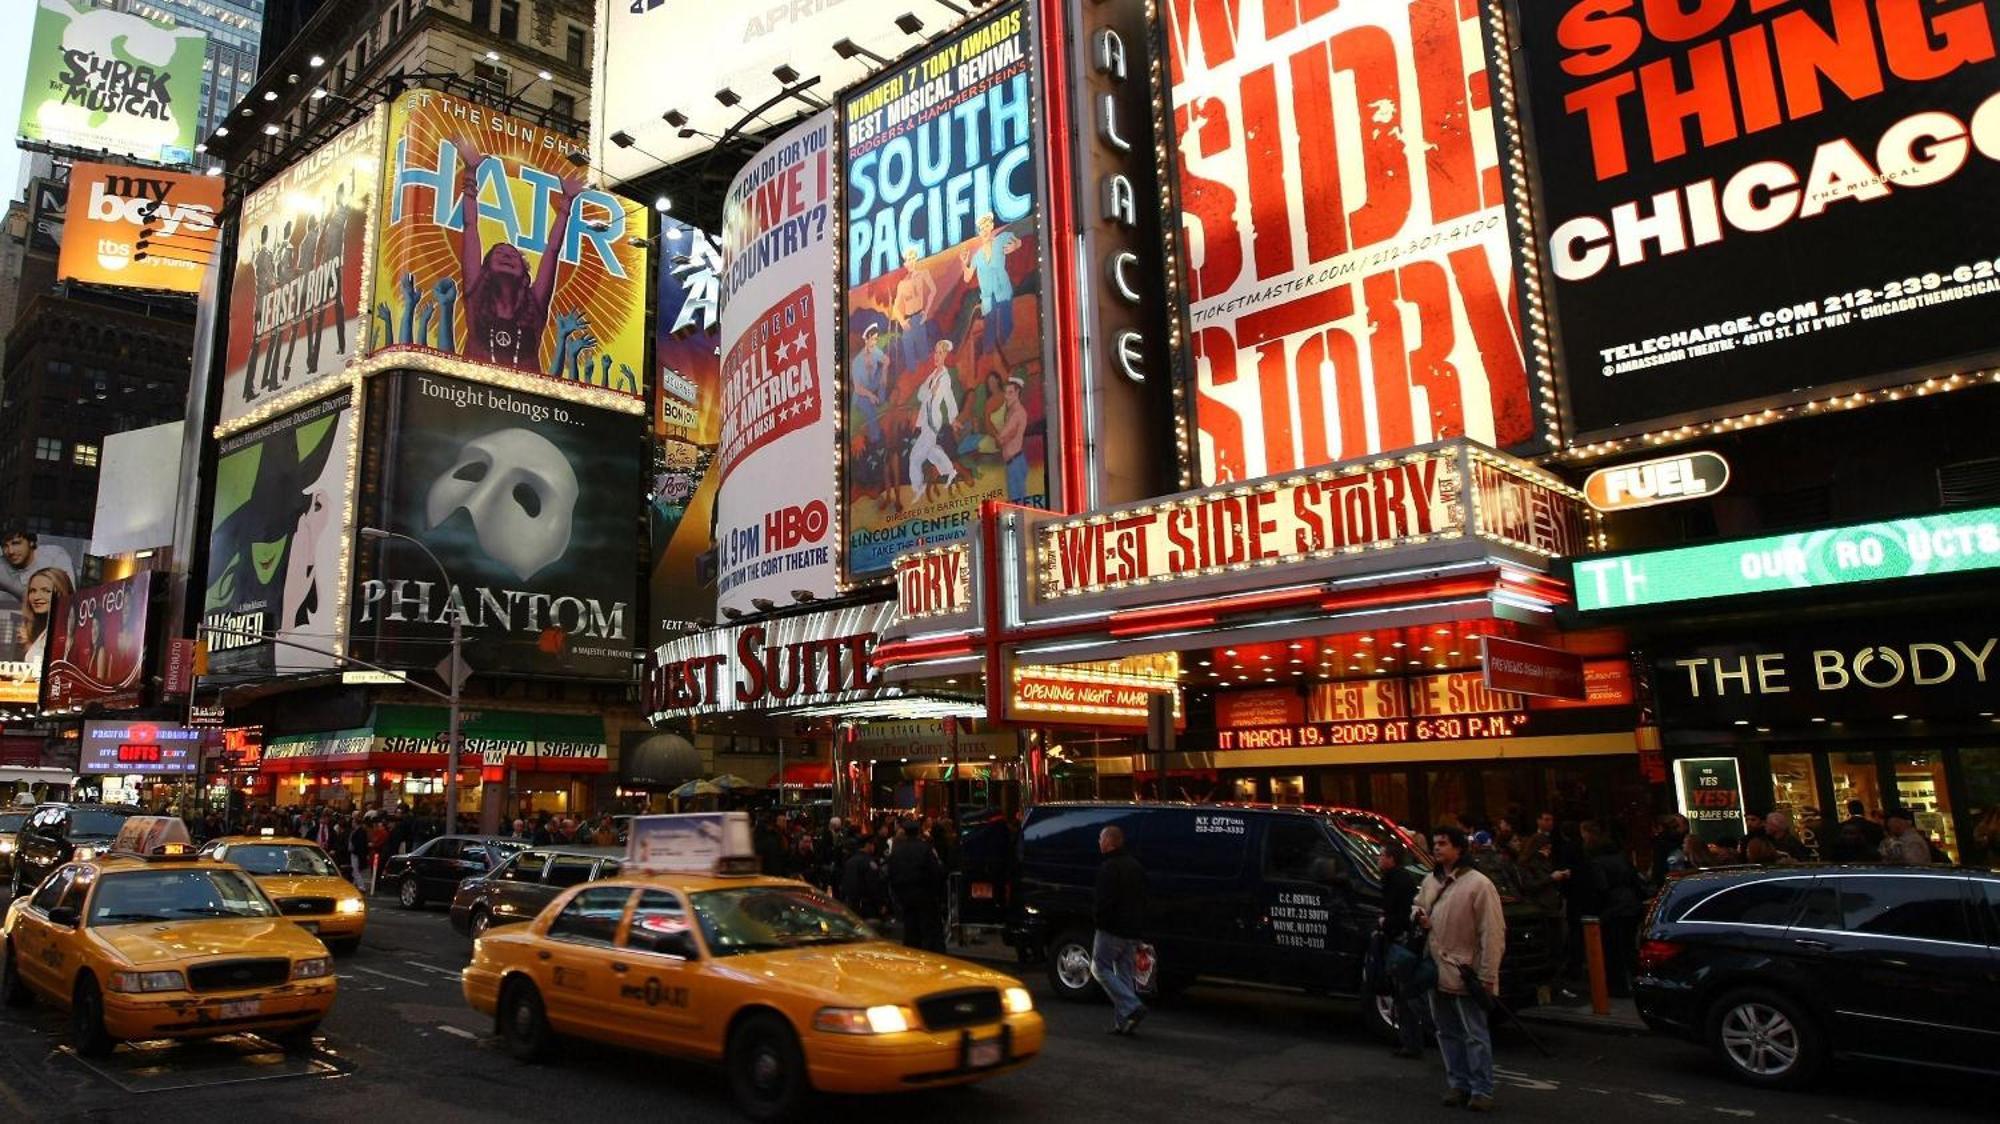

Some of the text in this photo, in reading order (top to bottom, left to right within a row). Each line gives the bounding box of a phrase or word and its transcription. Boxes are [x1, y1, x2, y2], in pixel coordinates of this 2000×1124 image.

[59, 46, 172, 104] SHREK
[848, 75, 904, 120] WINNER!
[907, 67, 917, 90] 7
[921, 44, 959, 82] TONY
[849, 35, 1024, 149] BEST MUSICAL REVIVAL
[61, 86, 170, 121] MUSICAL
[441, 98, 480, 126] THE
[491, 118, 533, 142] SUN
[850, 62, 1027, 159] RODGERS & HAMMERSTEIN'S
[743, 167, 759, 199] CAN
[761, 156, 775, 183] DO
[778, 141, 799, 171] FOR
[802, 125, 827, 157] YOU
[850, 73, 1030, 220] SOUTH
[1173, 0, 1504, 300] SIDE
[106, 174, 175, 217] my
[816, 148, 827, 203] I
[1847, 167, 1919, 191] MUSICAL
[87, 182, 216, 237] boys
[391, 136, 628, 280] HAIR
[850, 143, 1031, 287] PACIFIC
[97, 239, 130, 256] tbs
[731, 203, 828, 296] COUNTRY?
[1193, 261, 1356, 325] TICKETMASTER.COM
[1372, 215, 1500, 267] 212-307-4100
[257, 256, 339, 335] JERSEY BOYS
[752, 295, 809, 351] EVENT
[1600, 301, 1818, 363] TELECHARGE.COM
[1190, 244, 1534, 486] STORY
[1615, 348, 1686, 374] AMBASSADOR
[1687, 337, 1735, 359] THEATRE
[1742, 329, 1774, 346] 49TH
[1776, 325, 1793, 340] ST.
[1796, 321, 1810, 336] AT
[418, 376, 585, 427] Tonight belongs to...
[741, 358, 813, 431] AMERICA
[754, 412, 776, 440] BUSH
[1604, 458, 1707, 503] FUEL
[851, 512, 970, 549] LINCOLN CENTER
[886, 507, 922, 523] DIRECTED
[924, 507, 936, 515] BY
[936, 494, 979, 514] BARTLETT
[1058, 457, 1439, 590] WEST SIDE STORY
[731, 523, 760, 567] 9PM
[764, 499, 829, 554] HBO
[872, 545, 895, 558] TAKE
[747, 562, 759, 581] THE
[761, 556, 783, 577] CORT
[785, 546, 829, 571] THEATRE
[1741, 543, 1808, 580] OUR
[79, 586, 125, 627] go red
[358, 579, 628, 641] PHANTOM
[662, 619, 682, 630] TEXT
[208, 610, 264, 652] WICKED
[1676, 638, 1999, 697] THE BODY
[1023, 683, 1075, 702] OPENING
[1077, 688, 1115, 704] NIGHT:
[1310, 680, 1370, 723] WEST
[1377, 675, 1440, 718] SIDE
[119, 745, 158, 761] GIFTS
[463, 735, 528, 757] sbarro
[542, 740, 600, 759] sbarro
[1239, 728, 1292, 748] MARCH
[1300, 727, 1324, 746] 19,
[1331, 723, 1378, 744] 2009
[1385, 722, 1408, 741] AT
[1416, 719, 1461, 740] 6:30
[1693, 789, 1737, 808] YES!
[1699, 776, 1718, 786] YES
[1688, 810, 1740, 820] TO SAFE SEX
[1293, 894, 1320, 906] RENTALS
[1308, 909, 1329, 921] SOUTH
